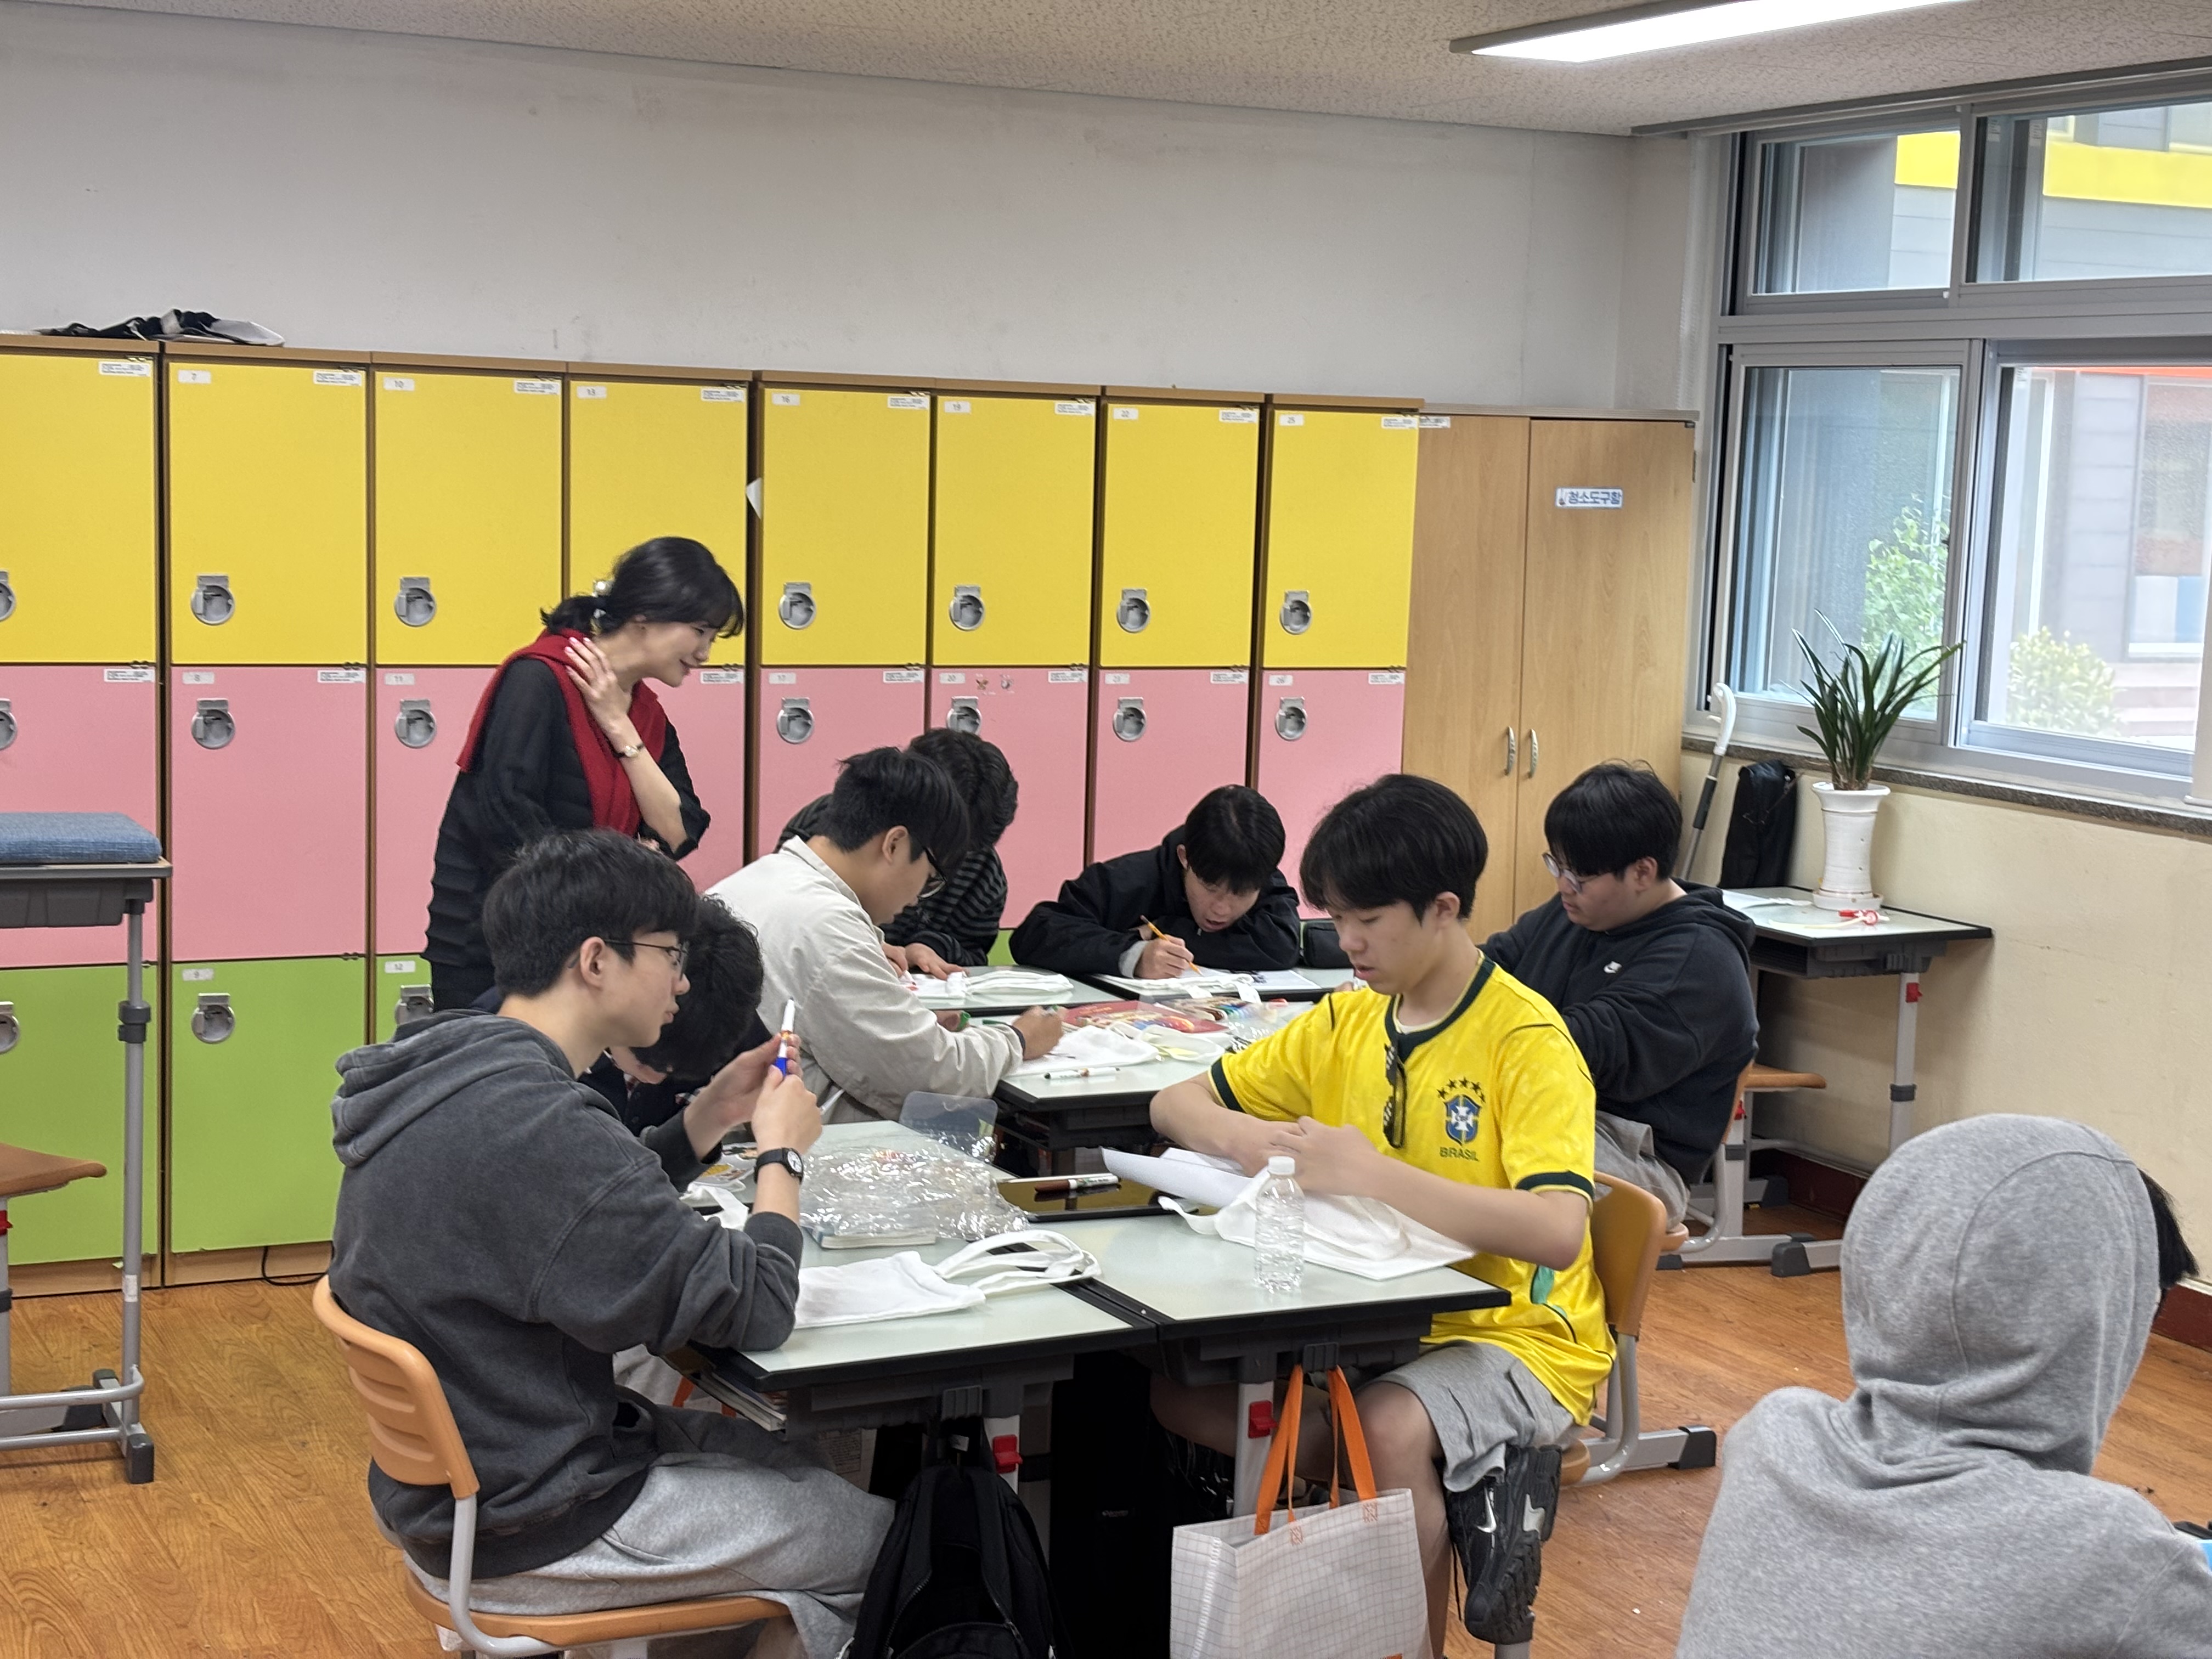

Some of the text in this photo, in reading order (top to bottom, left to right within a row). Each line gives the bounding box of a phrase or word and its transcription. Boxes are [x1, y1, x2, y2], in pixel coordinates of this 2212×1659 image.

[394, 380, 404, 388] 10
[586, 388, 596, 396] 13
[1568, 491, 1621, 505] 청소도구함
[1440, 1147, 1479, 1161] BRASIL
